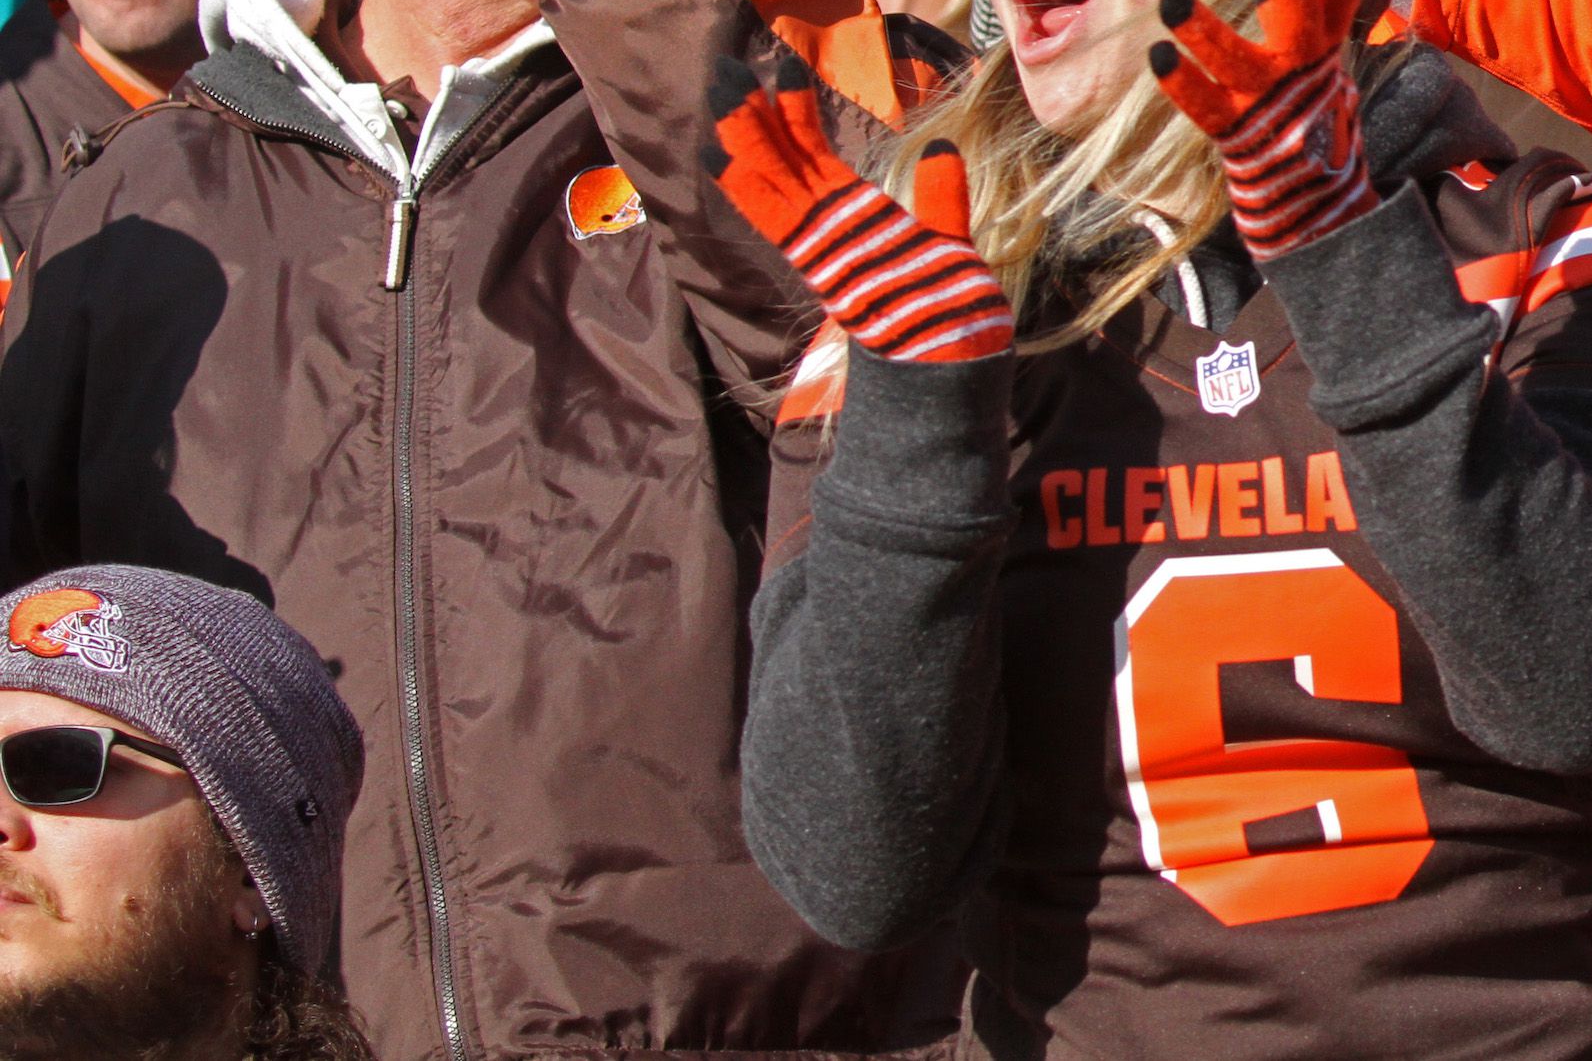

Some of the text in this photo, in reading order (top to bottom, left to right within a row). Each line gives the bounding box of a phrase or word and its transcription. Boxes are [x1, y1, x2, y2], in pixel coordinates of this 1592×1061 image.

[1207, 369, 1252, 403] NFL
[1040, 450, 1358, 550] CLEVELA
[1113, 547, 1436, 927] 6
